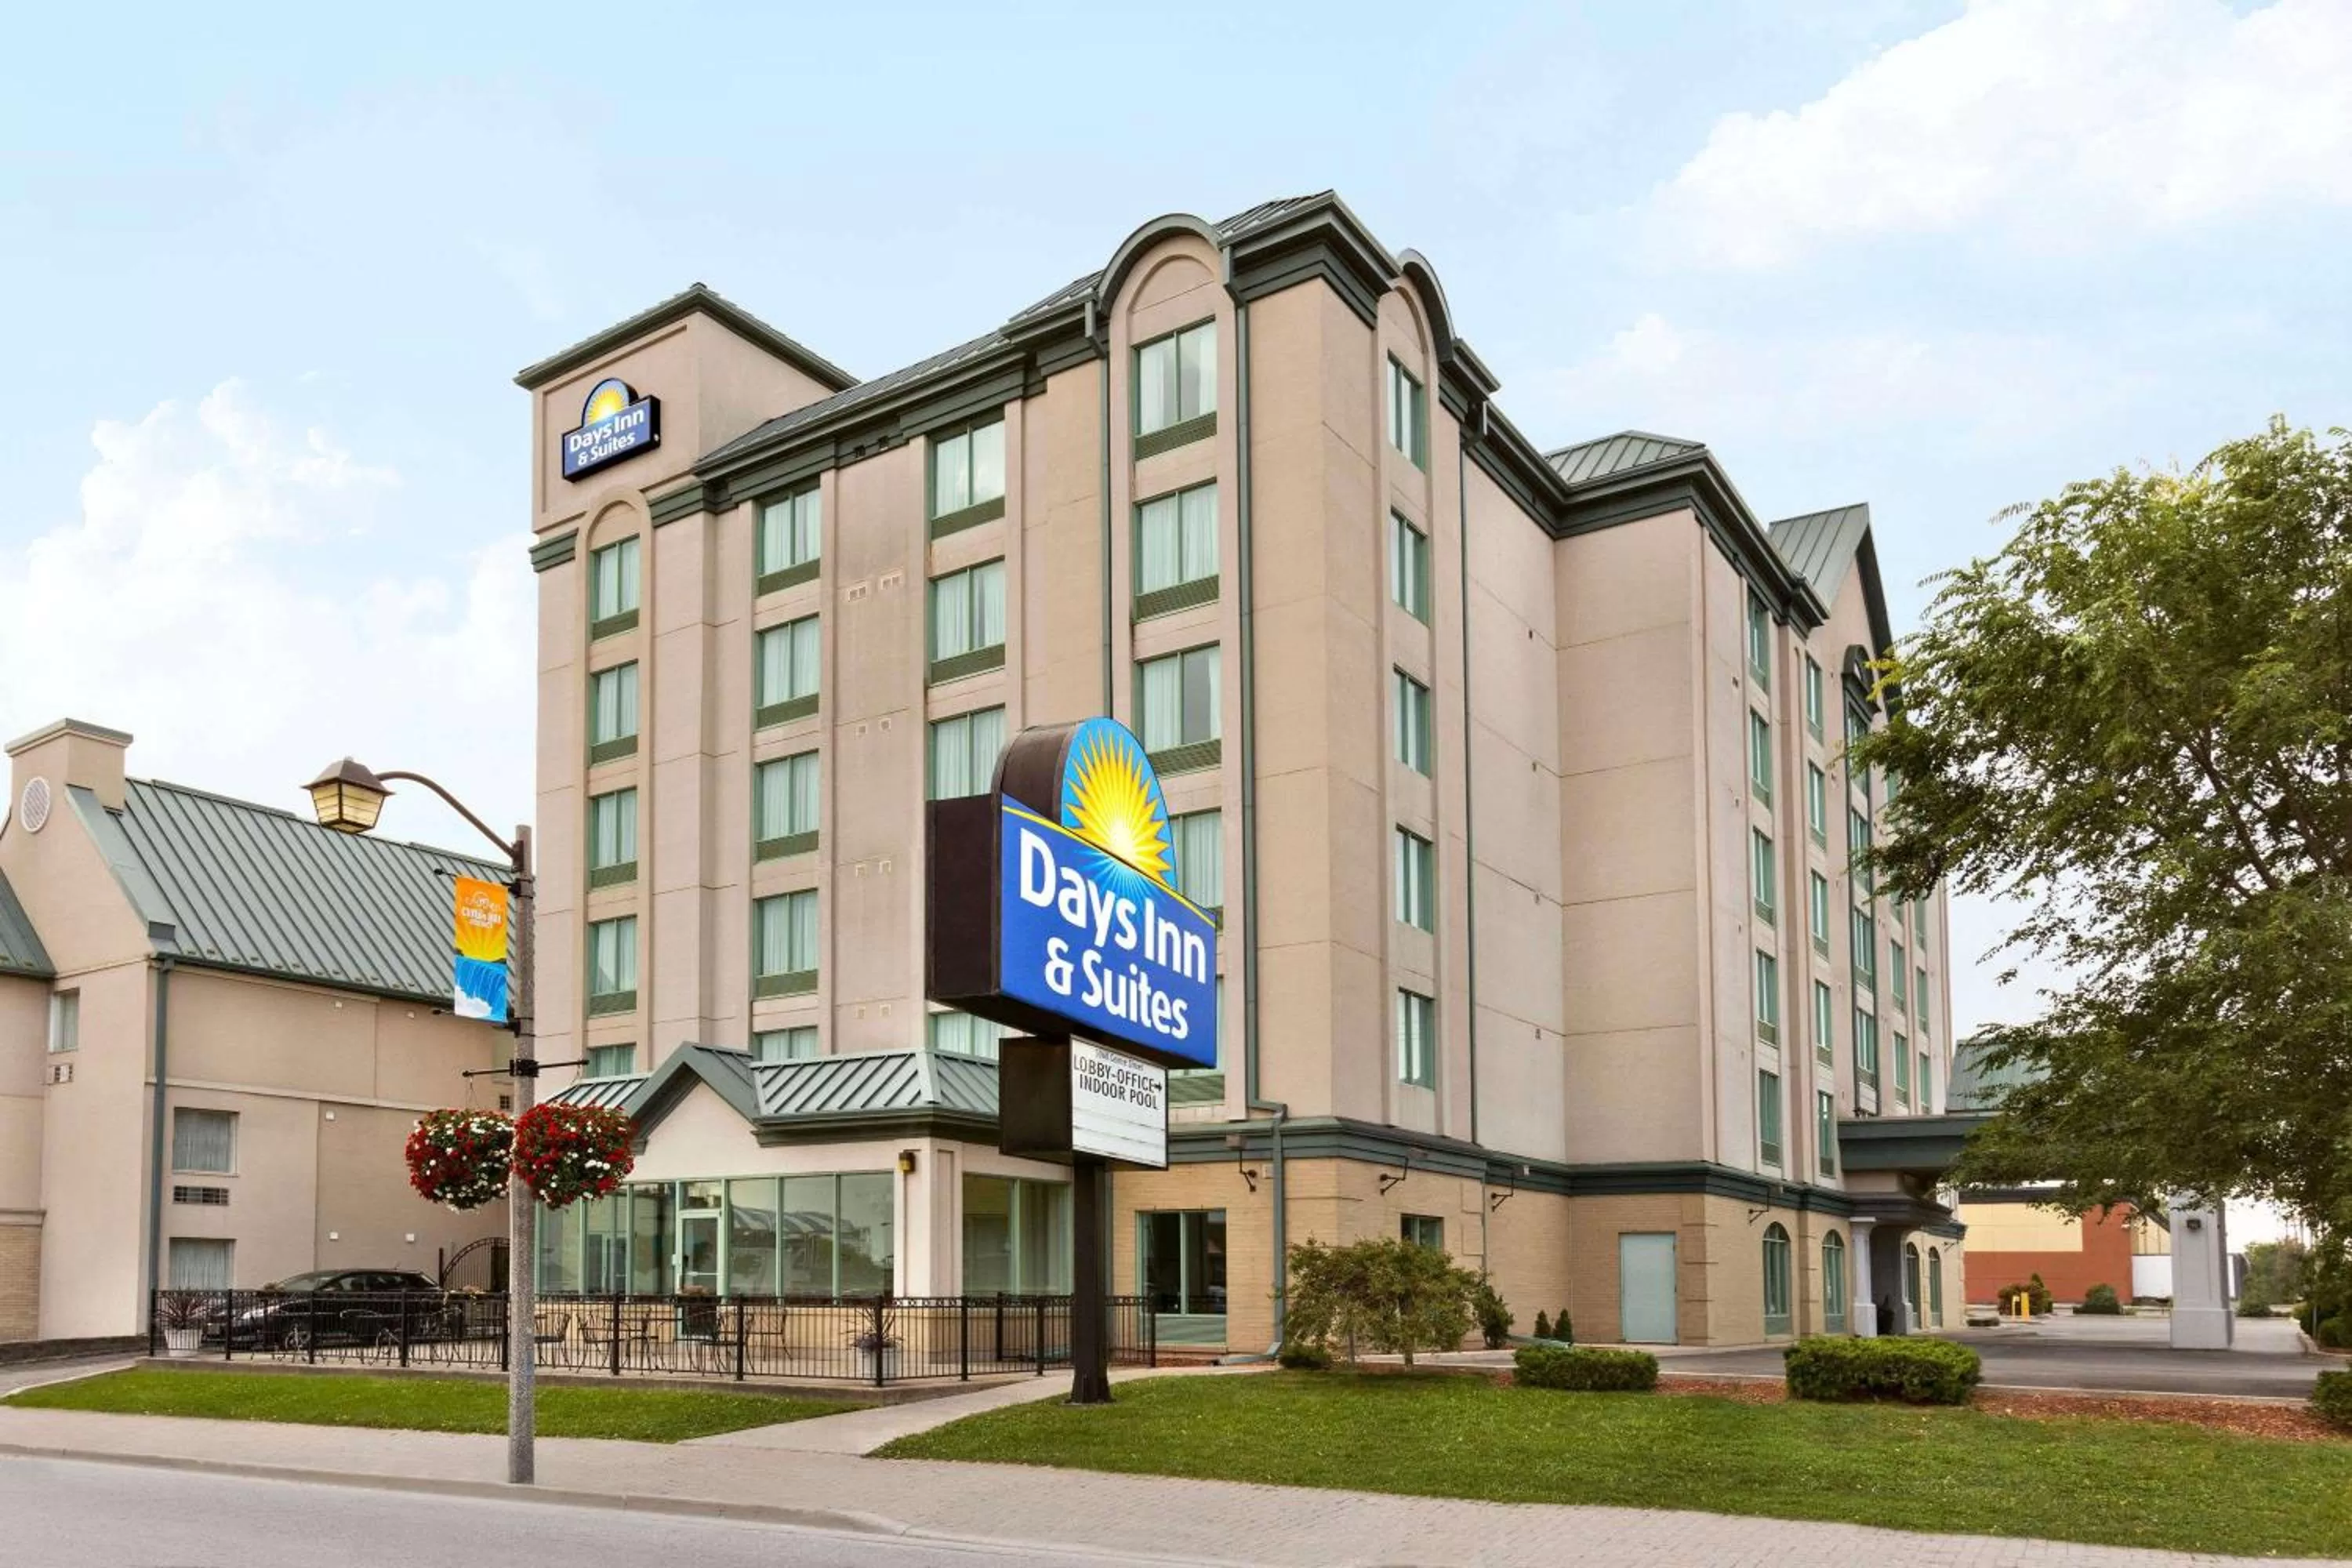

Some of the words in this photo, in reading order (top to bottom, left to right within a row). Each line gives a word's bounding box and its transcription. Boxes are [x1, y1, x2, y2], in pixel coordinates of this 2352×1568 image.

[569, 423, 612, 452] Days
[614, 408, 644, 434] Inn
[578, 451, 589, 466] &
[590, 432, 636, 461] Suites
[1020, 827, 1138, 950] Days
[1145, 898, 1207, 984] Inn
[1045, 937, 1075, 996] &
[1081, 949, 1189, 1039] Suites
[1073, 1053, 1155, 1094] LOBBY-OFFICE
[1080, 1073, 1126, 1102] INDOOR
[1130, 1089, 1158, 1110] POOL
